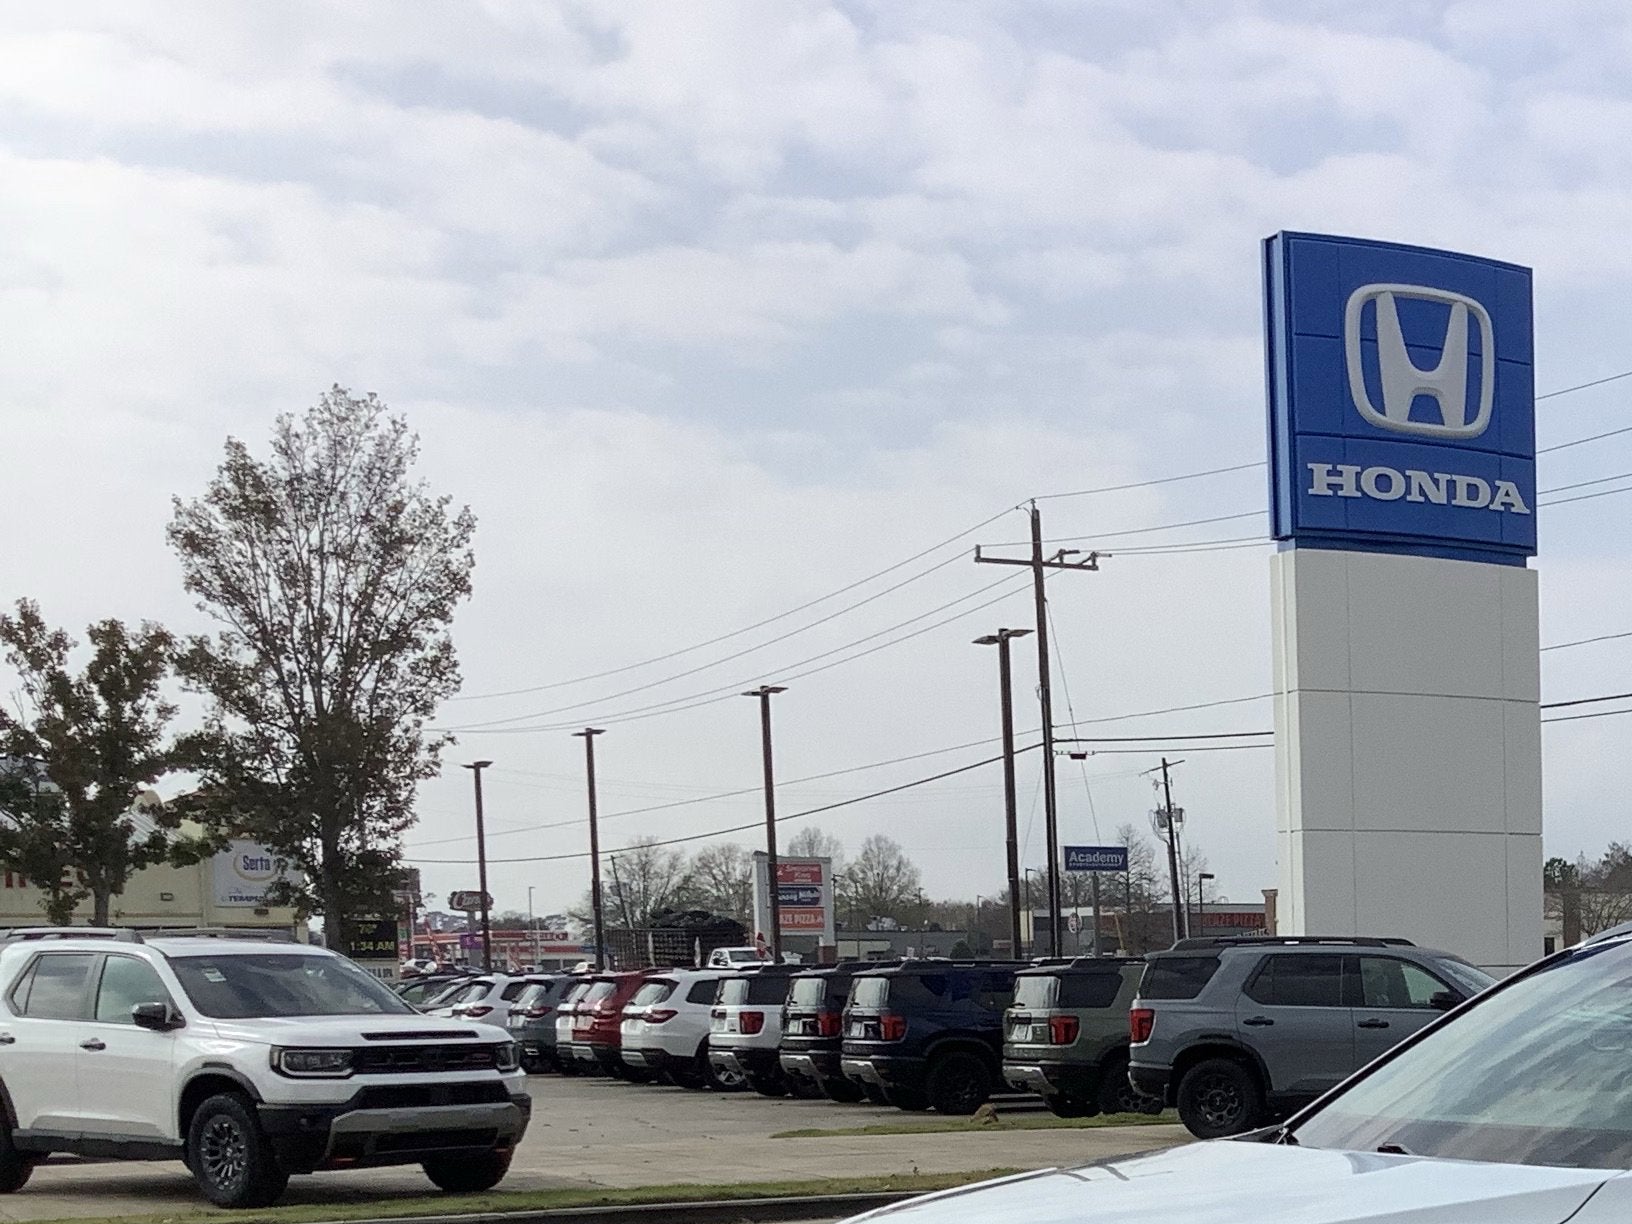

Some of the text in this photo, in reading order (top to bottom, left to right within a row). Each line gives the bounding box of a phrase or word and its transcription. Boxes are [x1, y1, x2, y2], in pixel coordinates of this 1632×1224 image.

[1307, 462, 1531, 515] HONDA
[242, 855, 271, 871] Serta
[1069, 851, 1124, 866] Academy
[375, 941, 395, 951] AM
